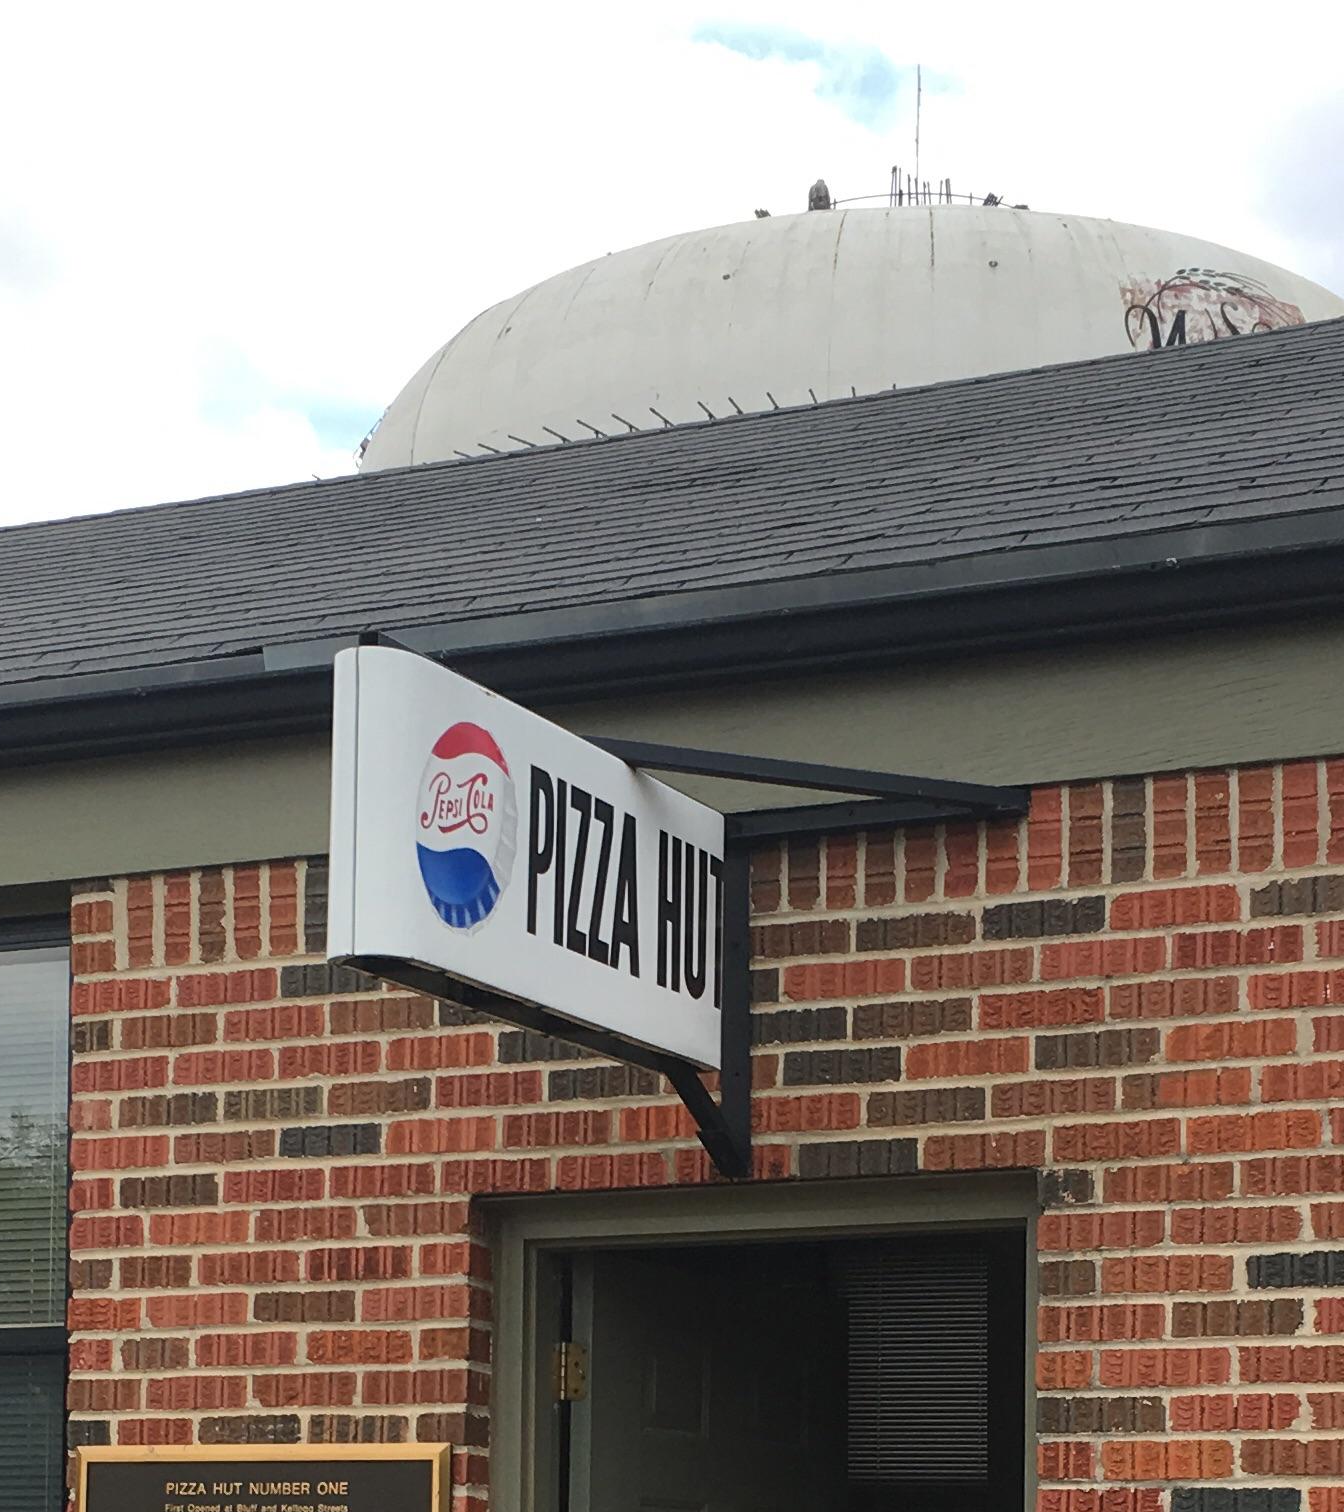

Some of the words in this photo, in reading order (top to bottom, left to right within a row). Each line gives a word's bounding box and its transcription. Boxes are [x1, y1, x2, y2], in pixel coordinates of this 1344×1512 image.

[527, 764, 640, 978] PIZZA
[657, 829, 724, 1009] HUT
[166, 1482, 207, 1495] PIZZA
[213, 1482, 243, 1495] HUT
[249, 1482, 310, 1495] NUMBER
[317, 1482, 349, 1495] ONE
[165, 1504, 184, 1512] First
[188, 1504, 221, 1512] Opened
[224, 1505, 233, 1512] at
[236, 1504, 258, 1512] Bluff
[261, 1504, 277, 1512] and
[318, 1504, 348, 1512] Streets
